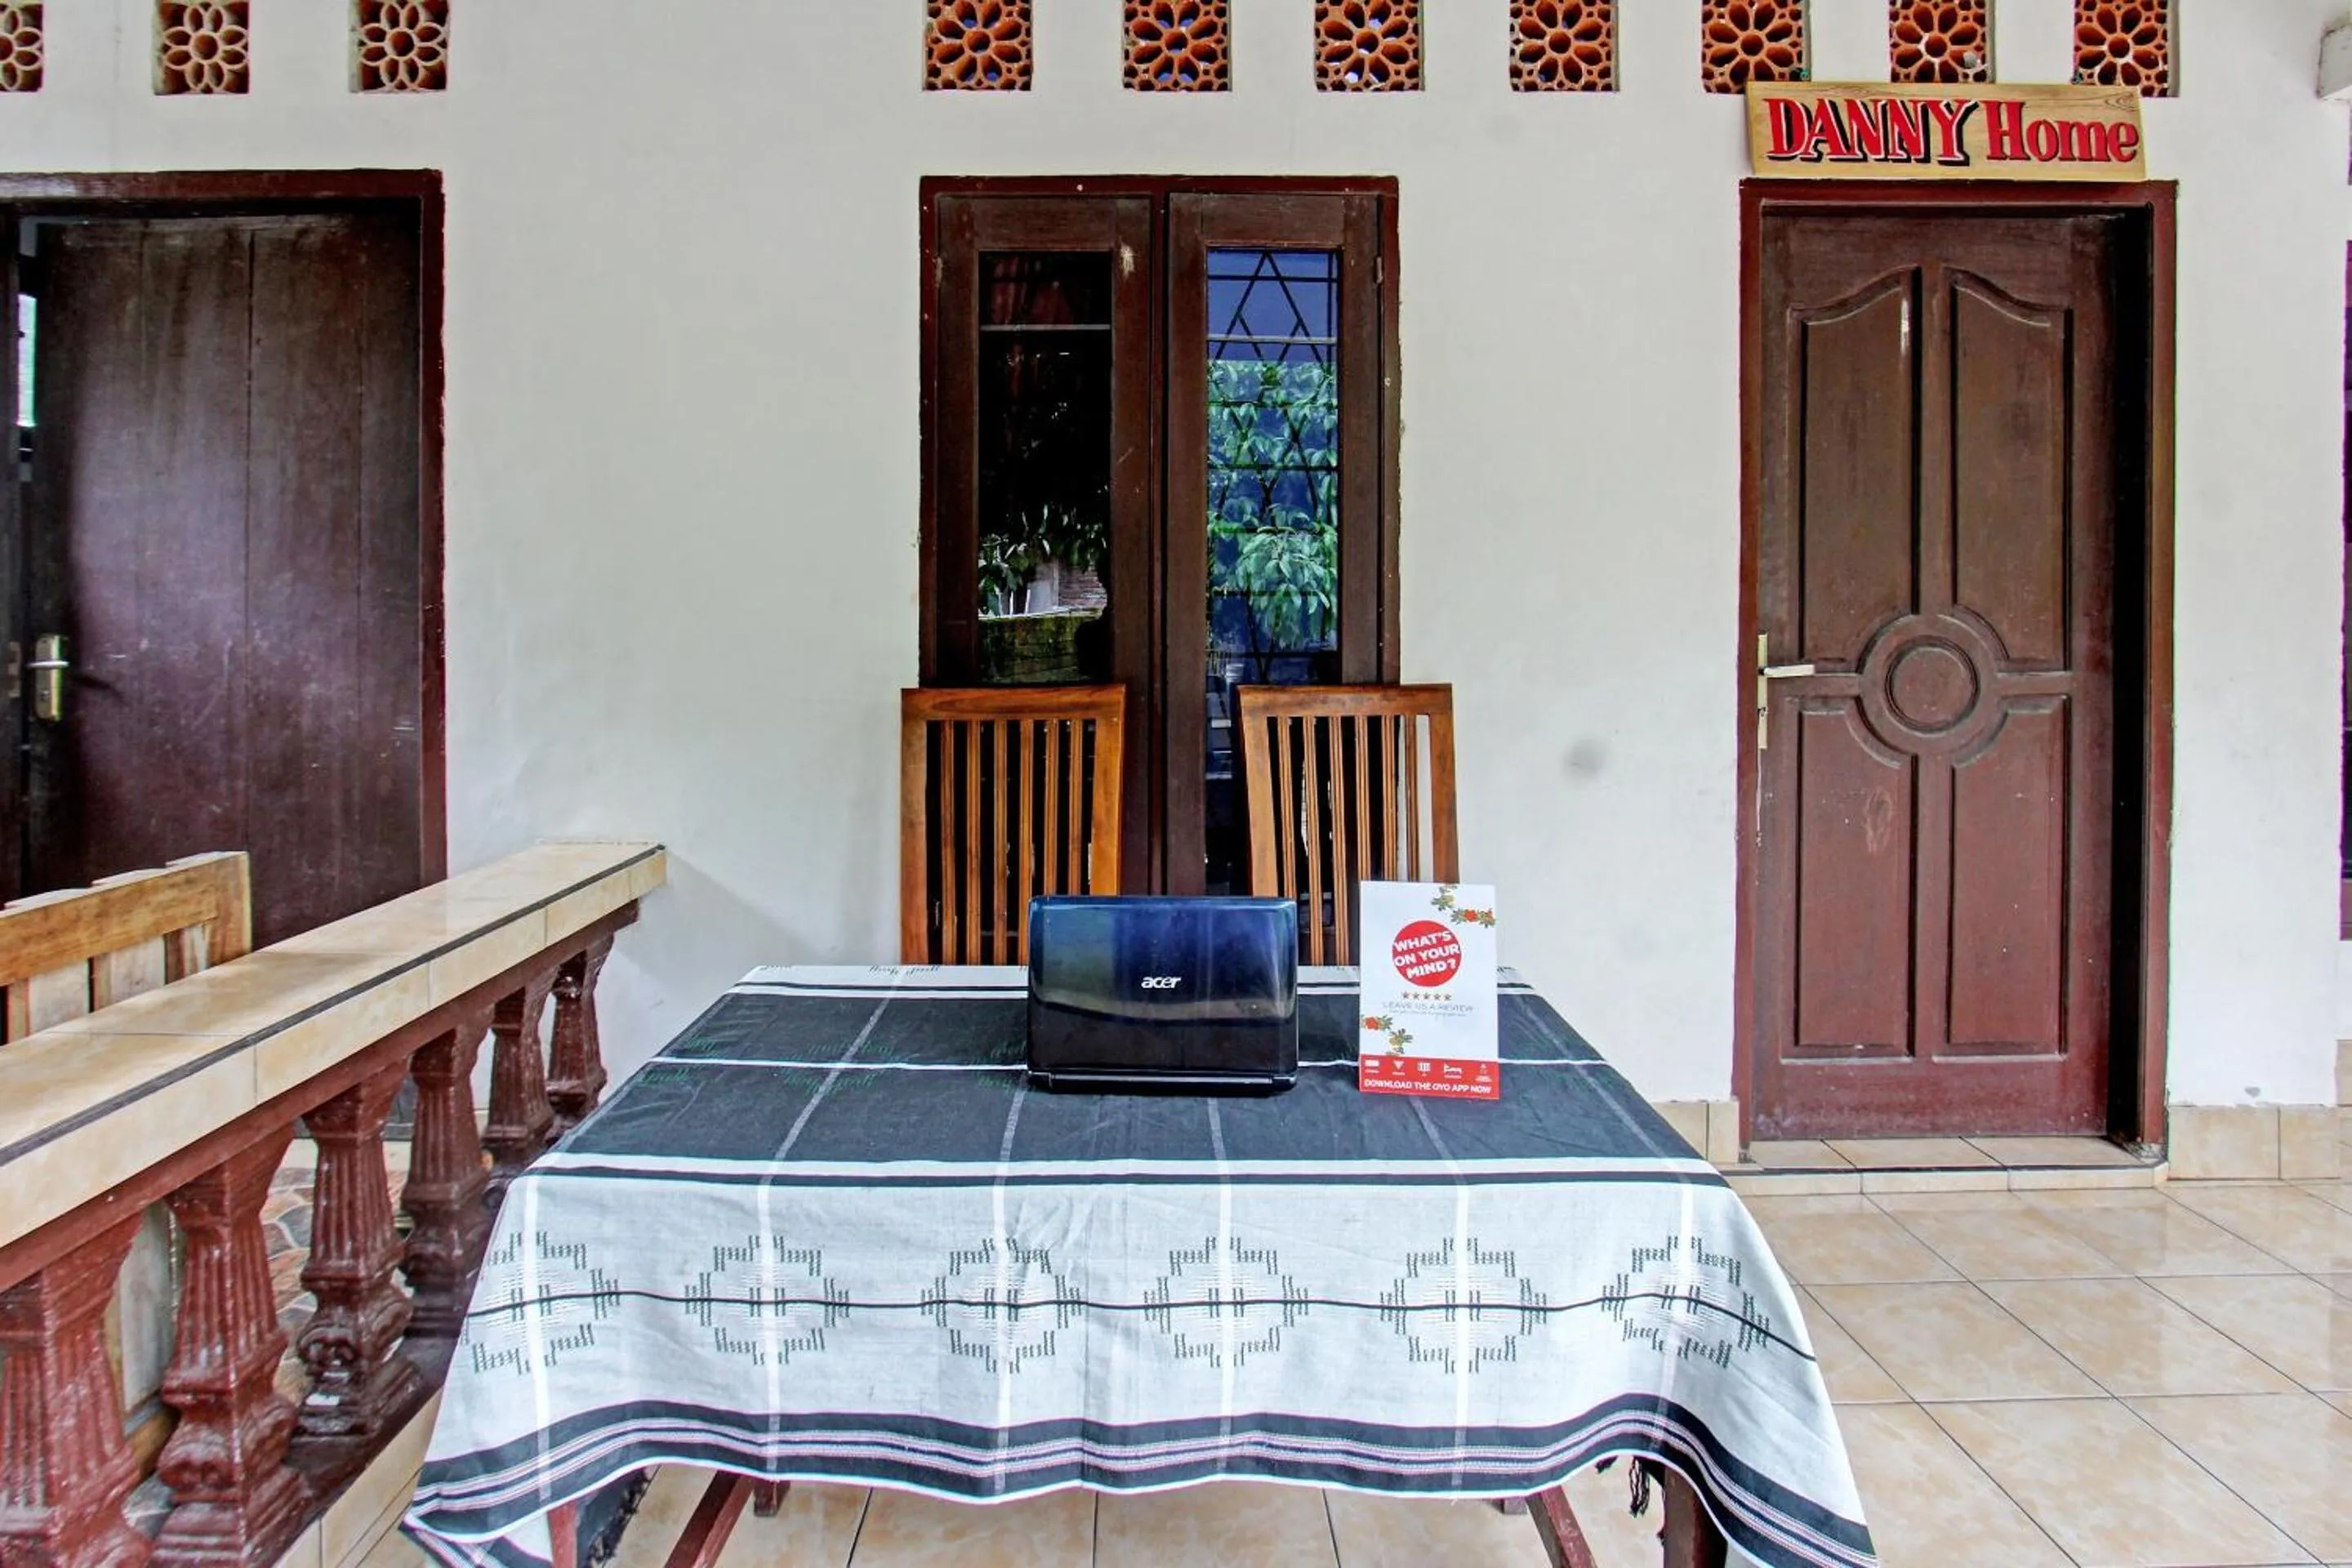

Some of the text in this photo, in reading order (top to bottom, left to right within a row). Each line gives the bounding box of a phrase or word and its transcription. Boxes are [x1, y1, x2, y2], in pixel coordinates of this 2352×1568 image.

[1764, 97, 2140, 166] DANNY Home
[1394, 929, 1452, 952] WHAT'S
[1393, 944, 1460, 968] ON YOUR
[1406, 959, 1456, 979] MIND?
[1141, 976, 1181, 989] acer
[1383, 1001, 1413, 1009] LEAVE
[1438, 1004, 1473, 1013] REVIEW
[1364, 1079, 1492, 1094] DOWNLOAD THE OYO APP NOW
